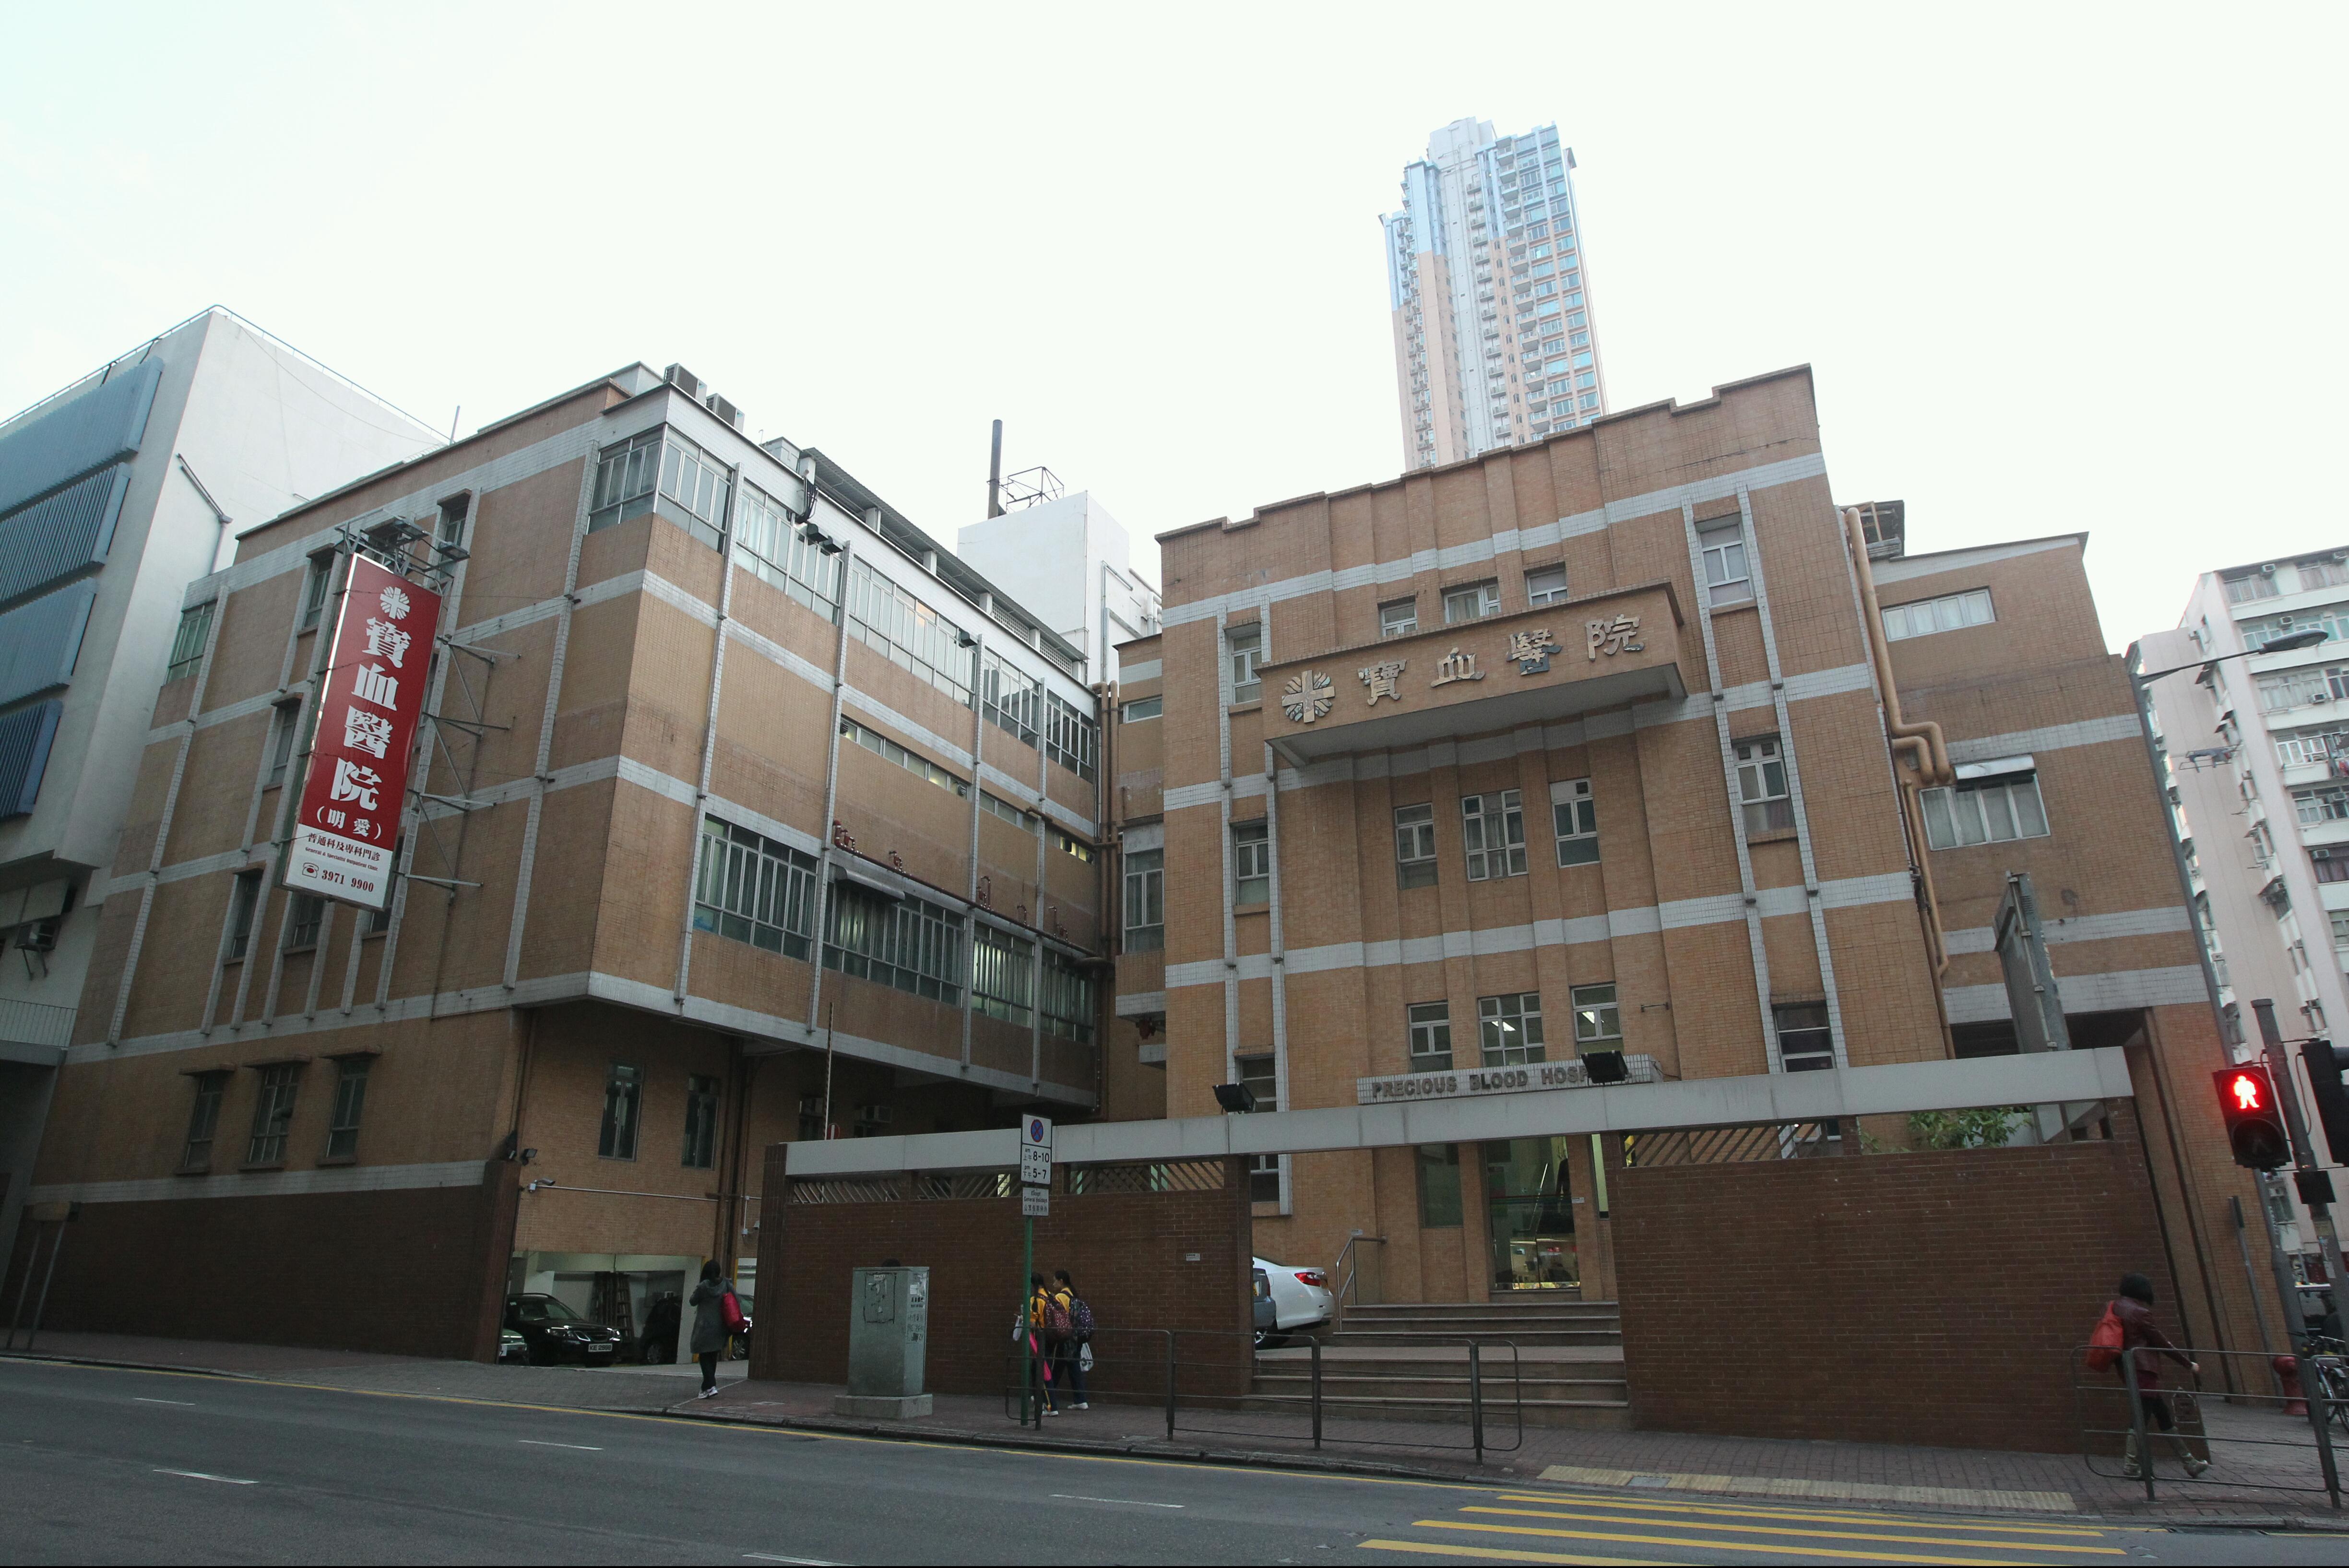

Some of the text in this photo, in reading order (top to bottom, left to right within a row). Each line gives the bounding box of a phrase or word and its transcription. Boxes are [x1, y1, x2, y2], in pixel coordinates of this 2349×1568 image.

[1358, 614, 1645, 705] 寶血醫院
[330, 617, 412, 811] 寶血醫院
[305, 846, 322, 855] General
[327, 853, 346, 861] Specialist
[346, 858, 367, 868] Outpatient
[308, 832, 380, 861] 普通科及專科門診
[321, 870, 374, 892] 3971 9900
[1372, 1076, 1457, 1098] PRECIOUS
[1469, 1070, 1528, 1090] BLOOD
[1033, 1151, 1049, 1163] 8-10
